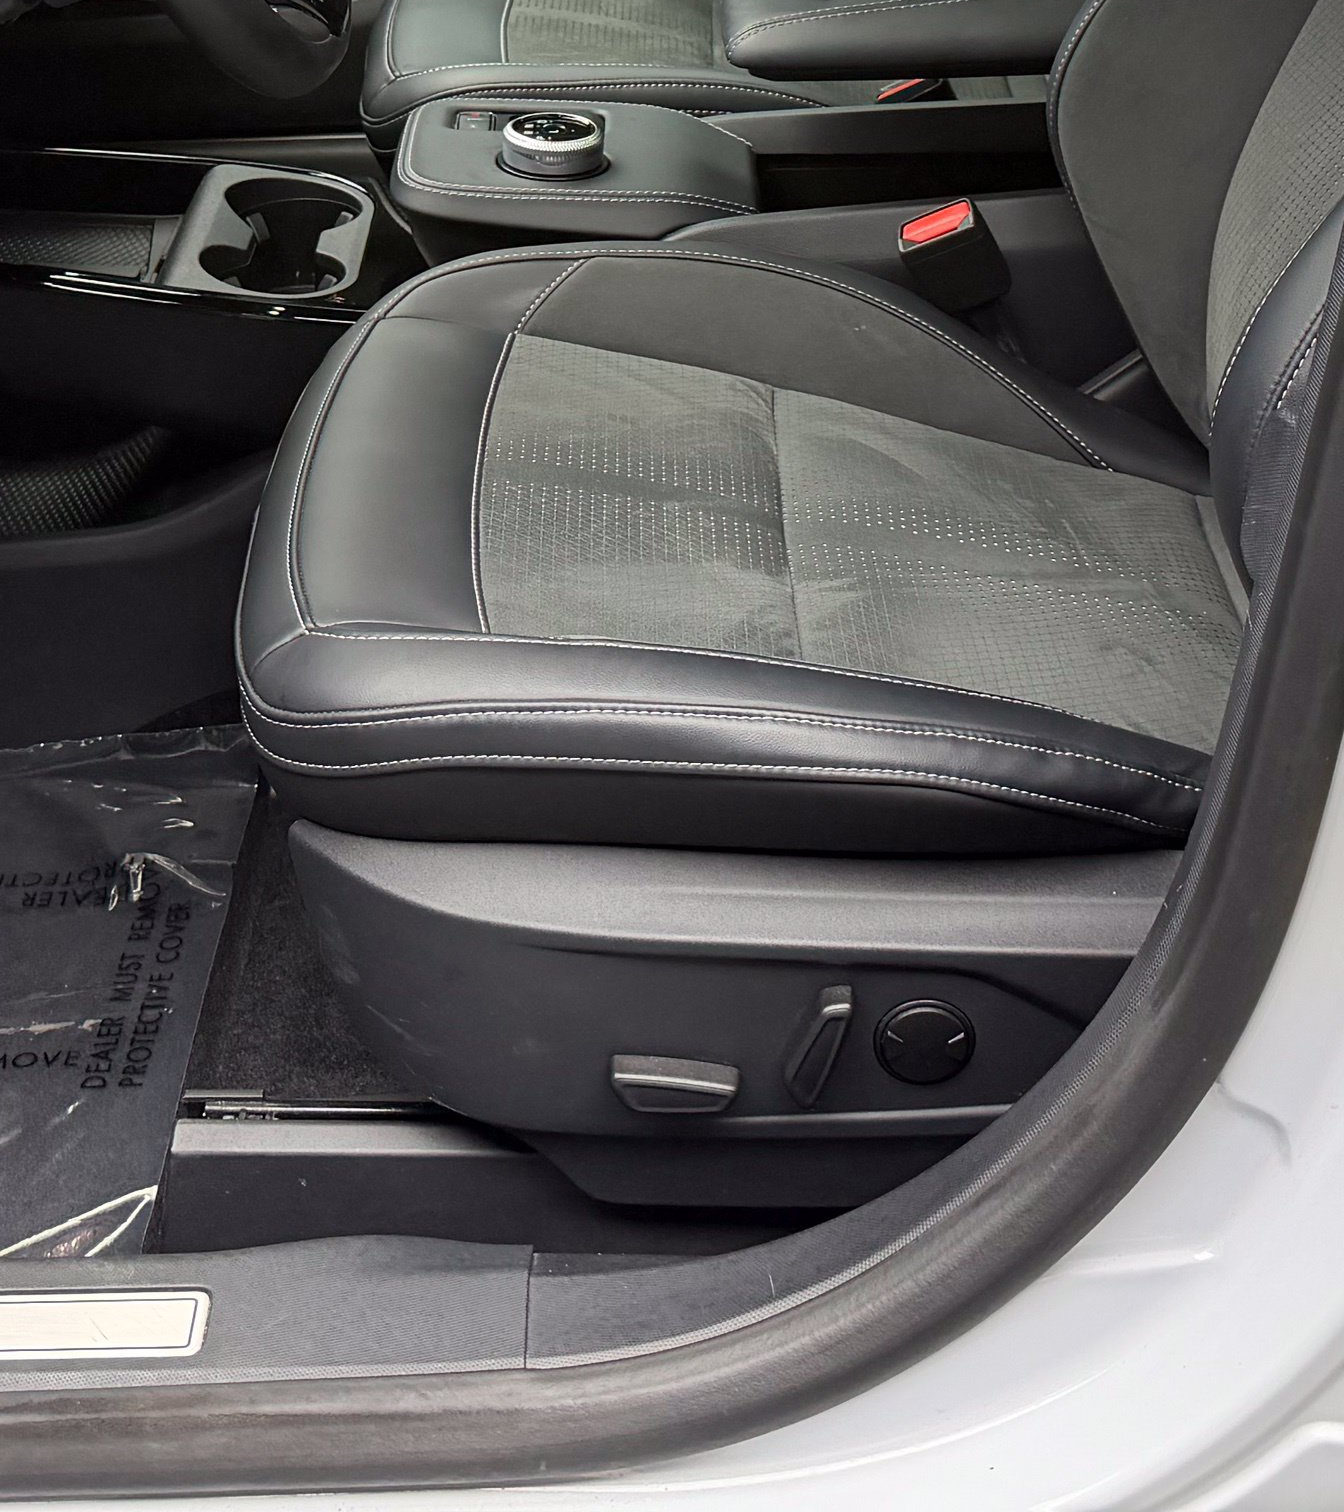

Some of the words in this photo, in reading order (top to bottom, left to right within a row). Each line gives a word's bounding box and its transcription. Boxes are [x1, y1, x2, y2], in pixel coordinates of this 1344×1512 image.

[81, 1017, 122, 1091] DEALER
[109, 952, 145, 1002] MUST
[127, 867, 162, 942] REMOV
[118, 972, 175, 1088] PROTECTIVE
[155, 900, 191, 965] COVER
